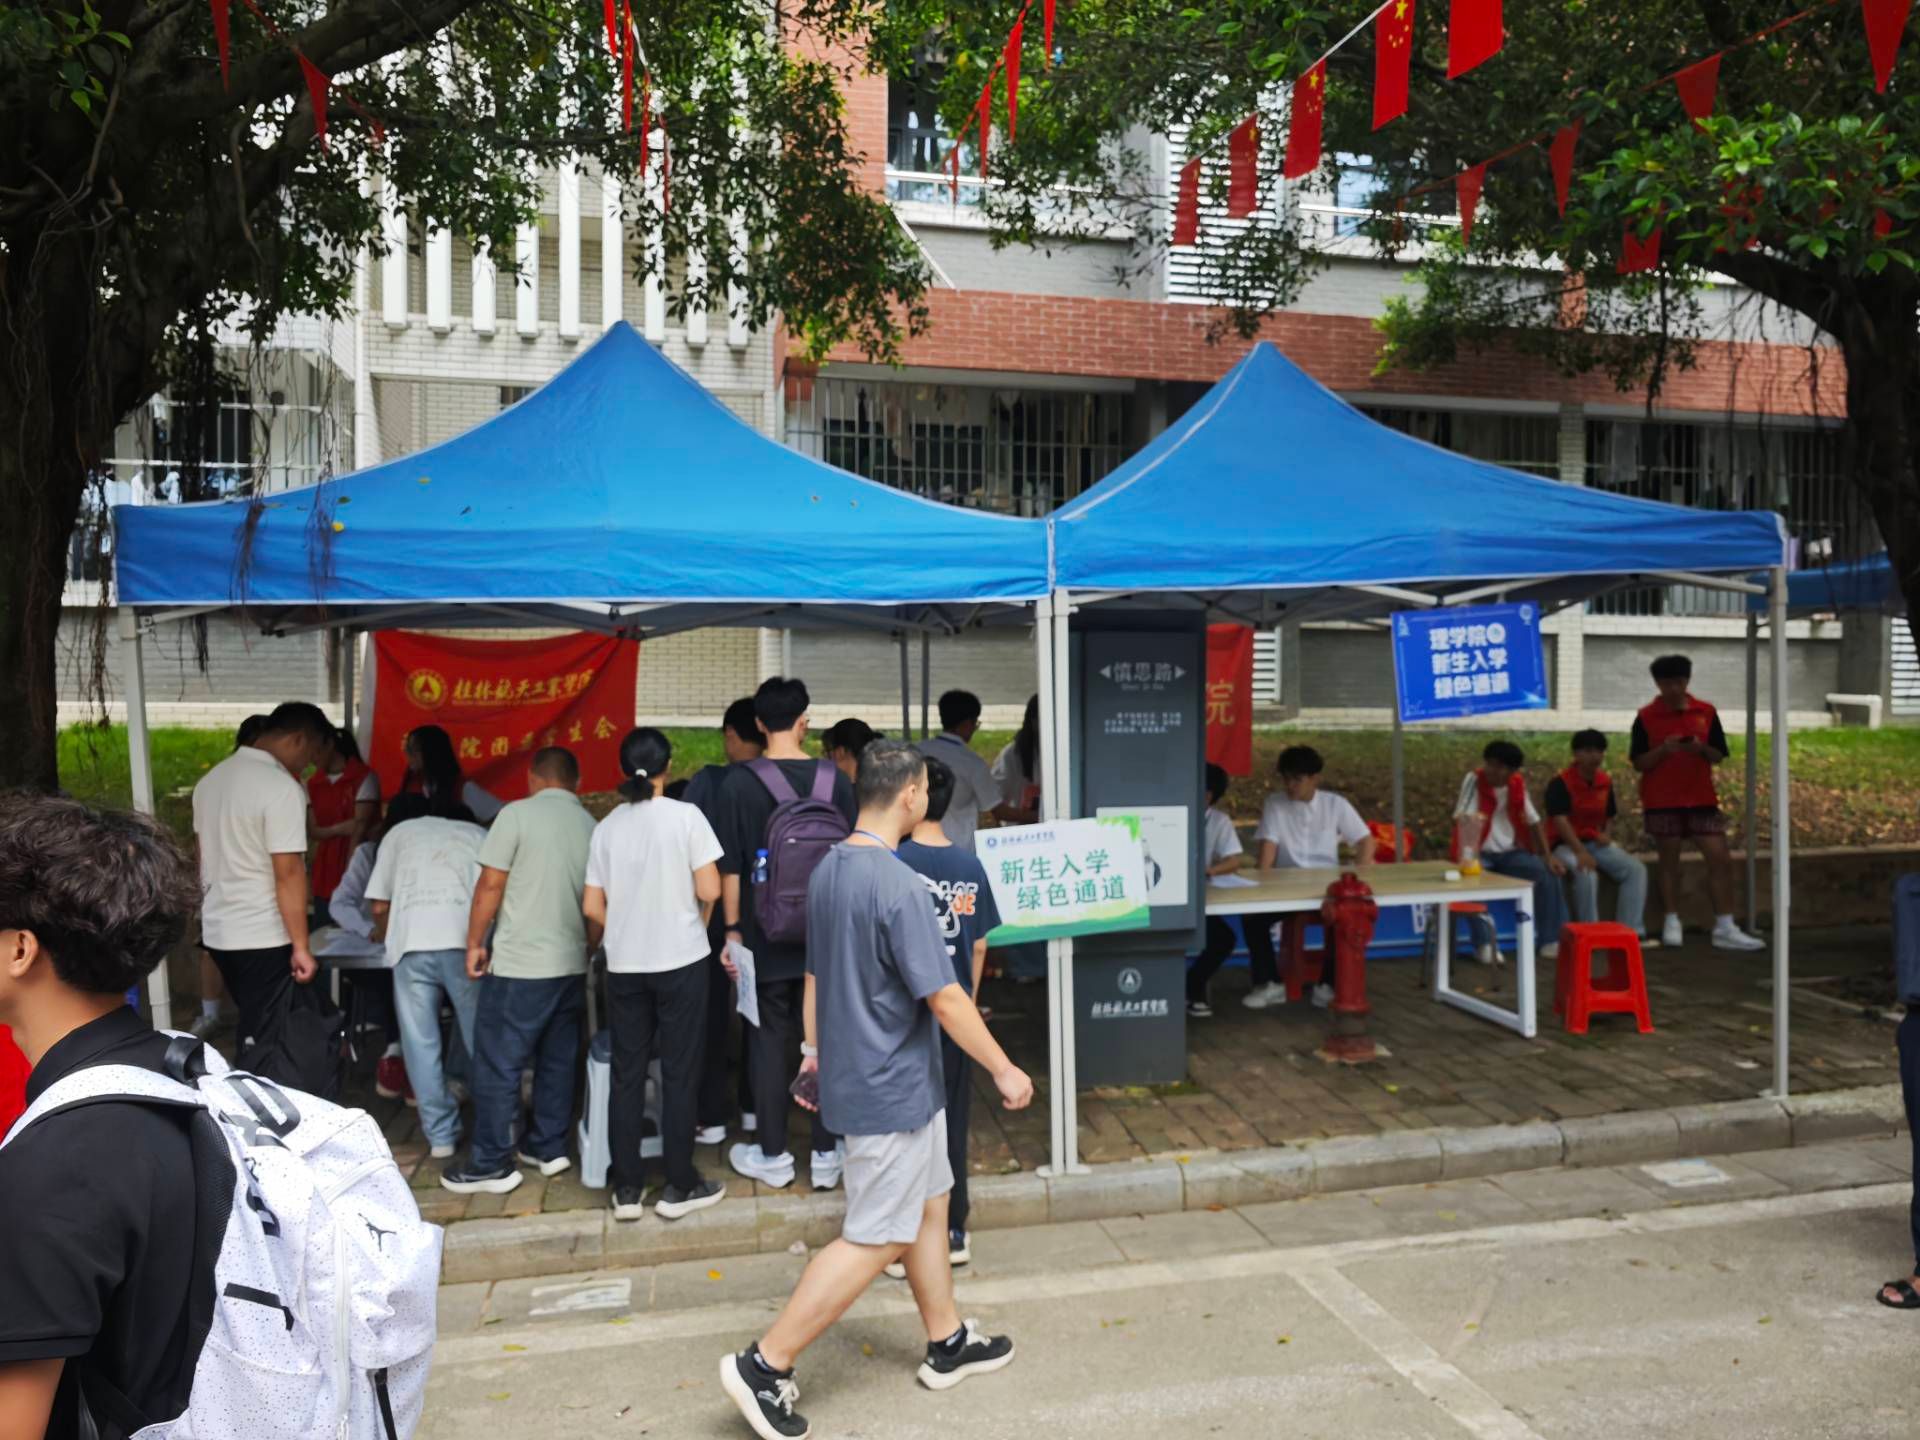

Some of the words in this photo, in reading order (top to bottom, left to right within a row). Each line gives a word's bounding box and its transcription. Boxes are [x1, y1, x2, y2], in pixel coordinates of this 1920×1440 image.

[1429, 623, 1487, 651] 理学院
[1431, 648, 1508, 675] 新生入学
[1434, 671, 1510, 699] 绿色通道
[1000, 849, 1110, 884] 新生入学
[1017, 875, 1126, 910] 绿色通道
